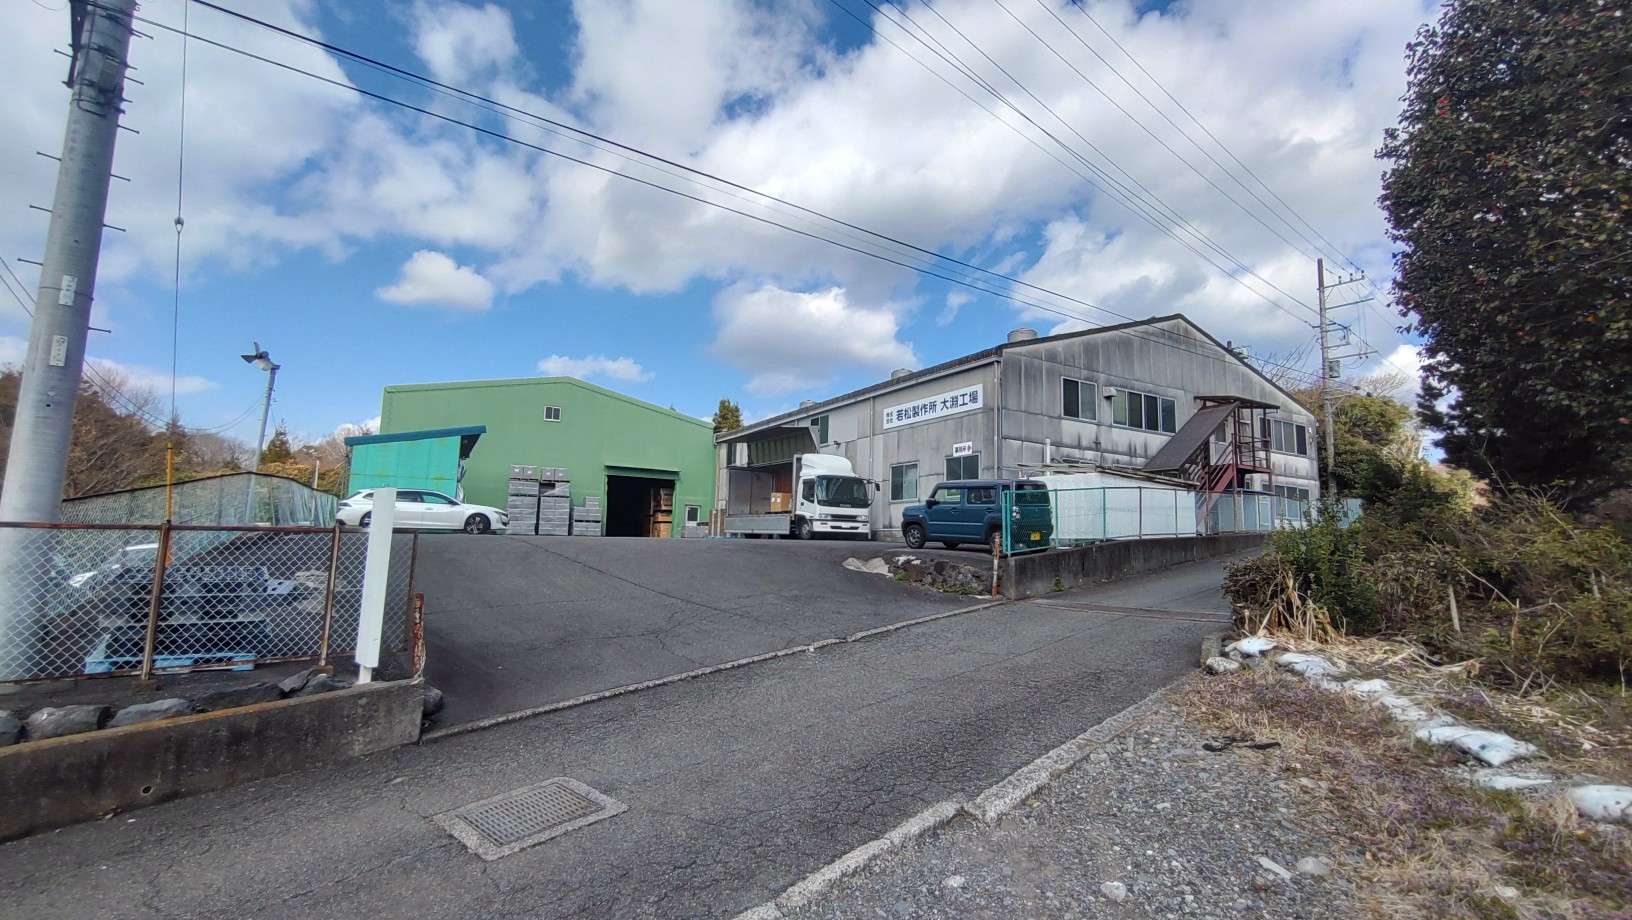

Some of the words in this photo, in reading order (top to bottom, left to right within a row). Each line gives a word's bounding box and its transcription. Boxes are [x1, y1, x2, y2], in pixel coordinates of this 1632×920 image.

[896, 400, 937, 421] 若松製作所
[940, 390, 979, 411] 大淵工場
